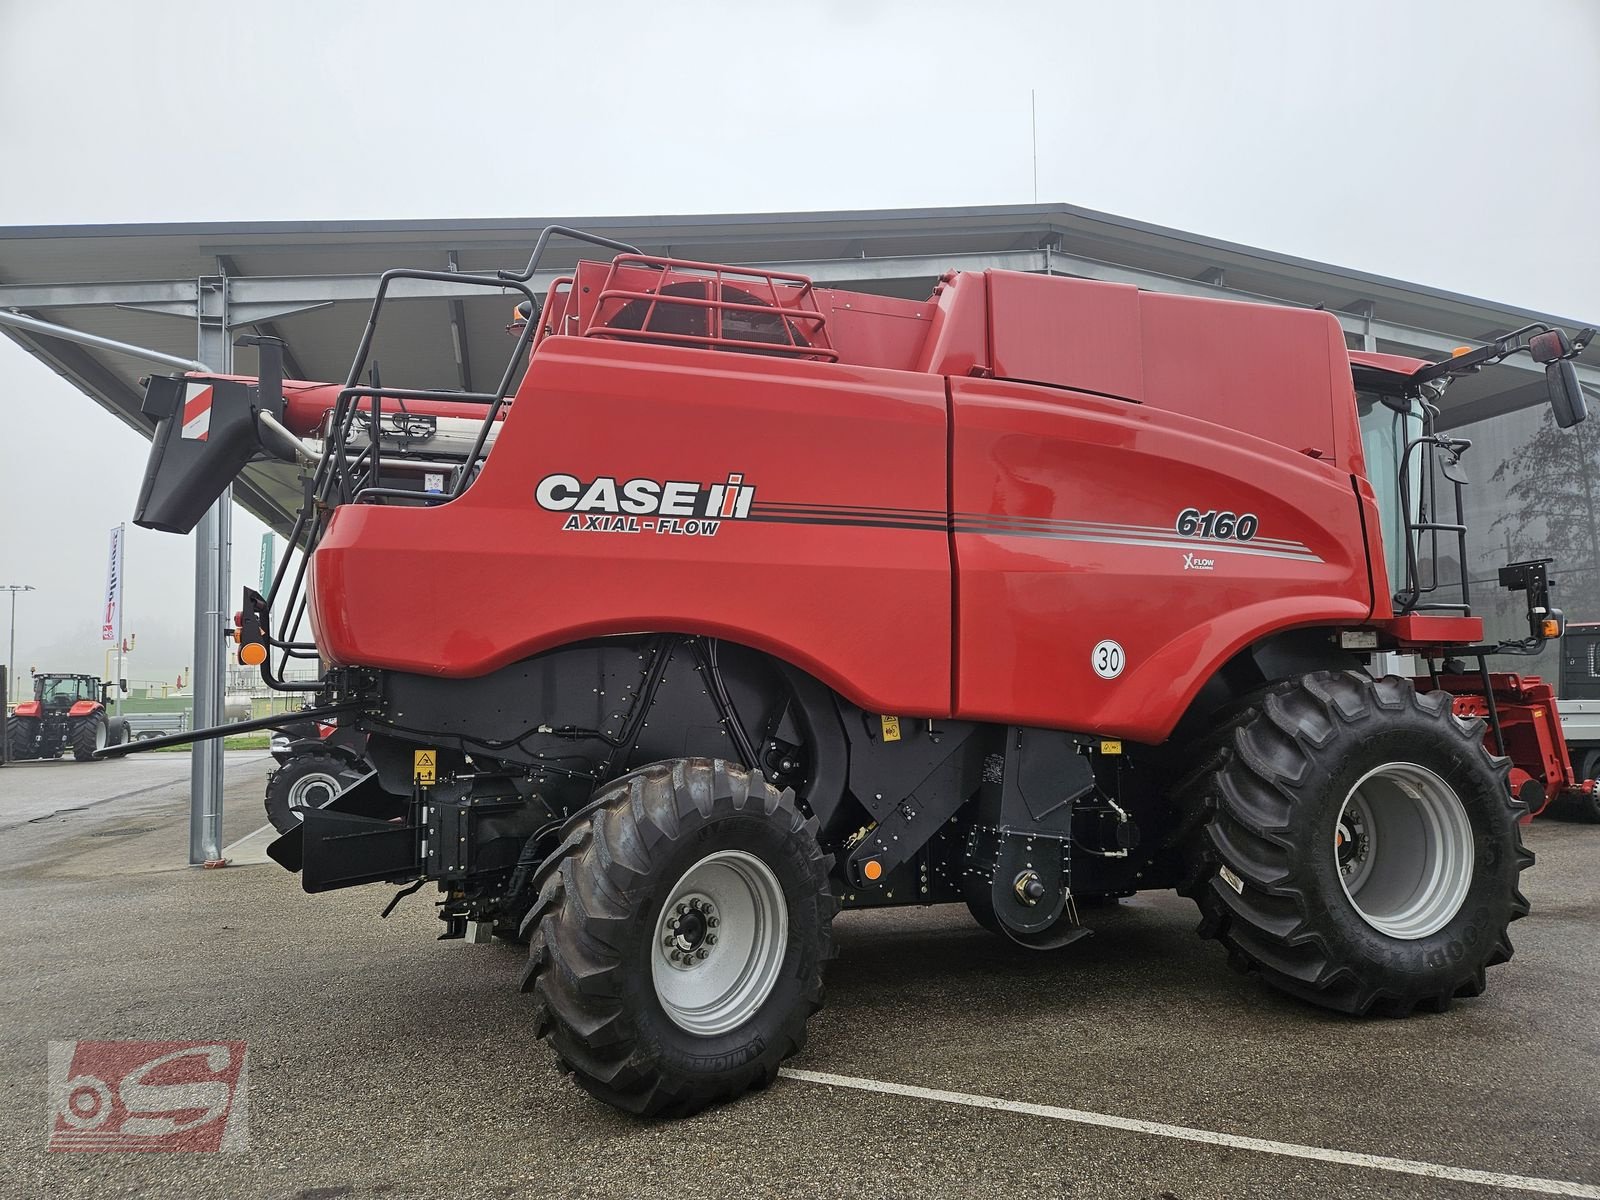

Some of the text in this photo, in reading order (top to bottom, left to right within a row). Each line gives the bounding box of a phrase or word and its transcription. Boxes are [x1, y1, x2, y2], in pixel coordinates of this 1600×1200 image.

[535, 473, 700, 515] CASE
[1176, 507, 1258, 541] 6160
[1194, 558, 1214, 566] FLOW
[1099, 647, 1119, 672] 30
